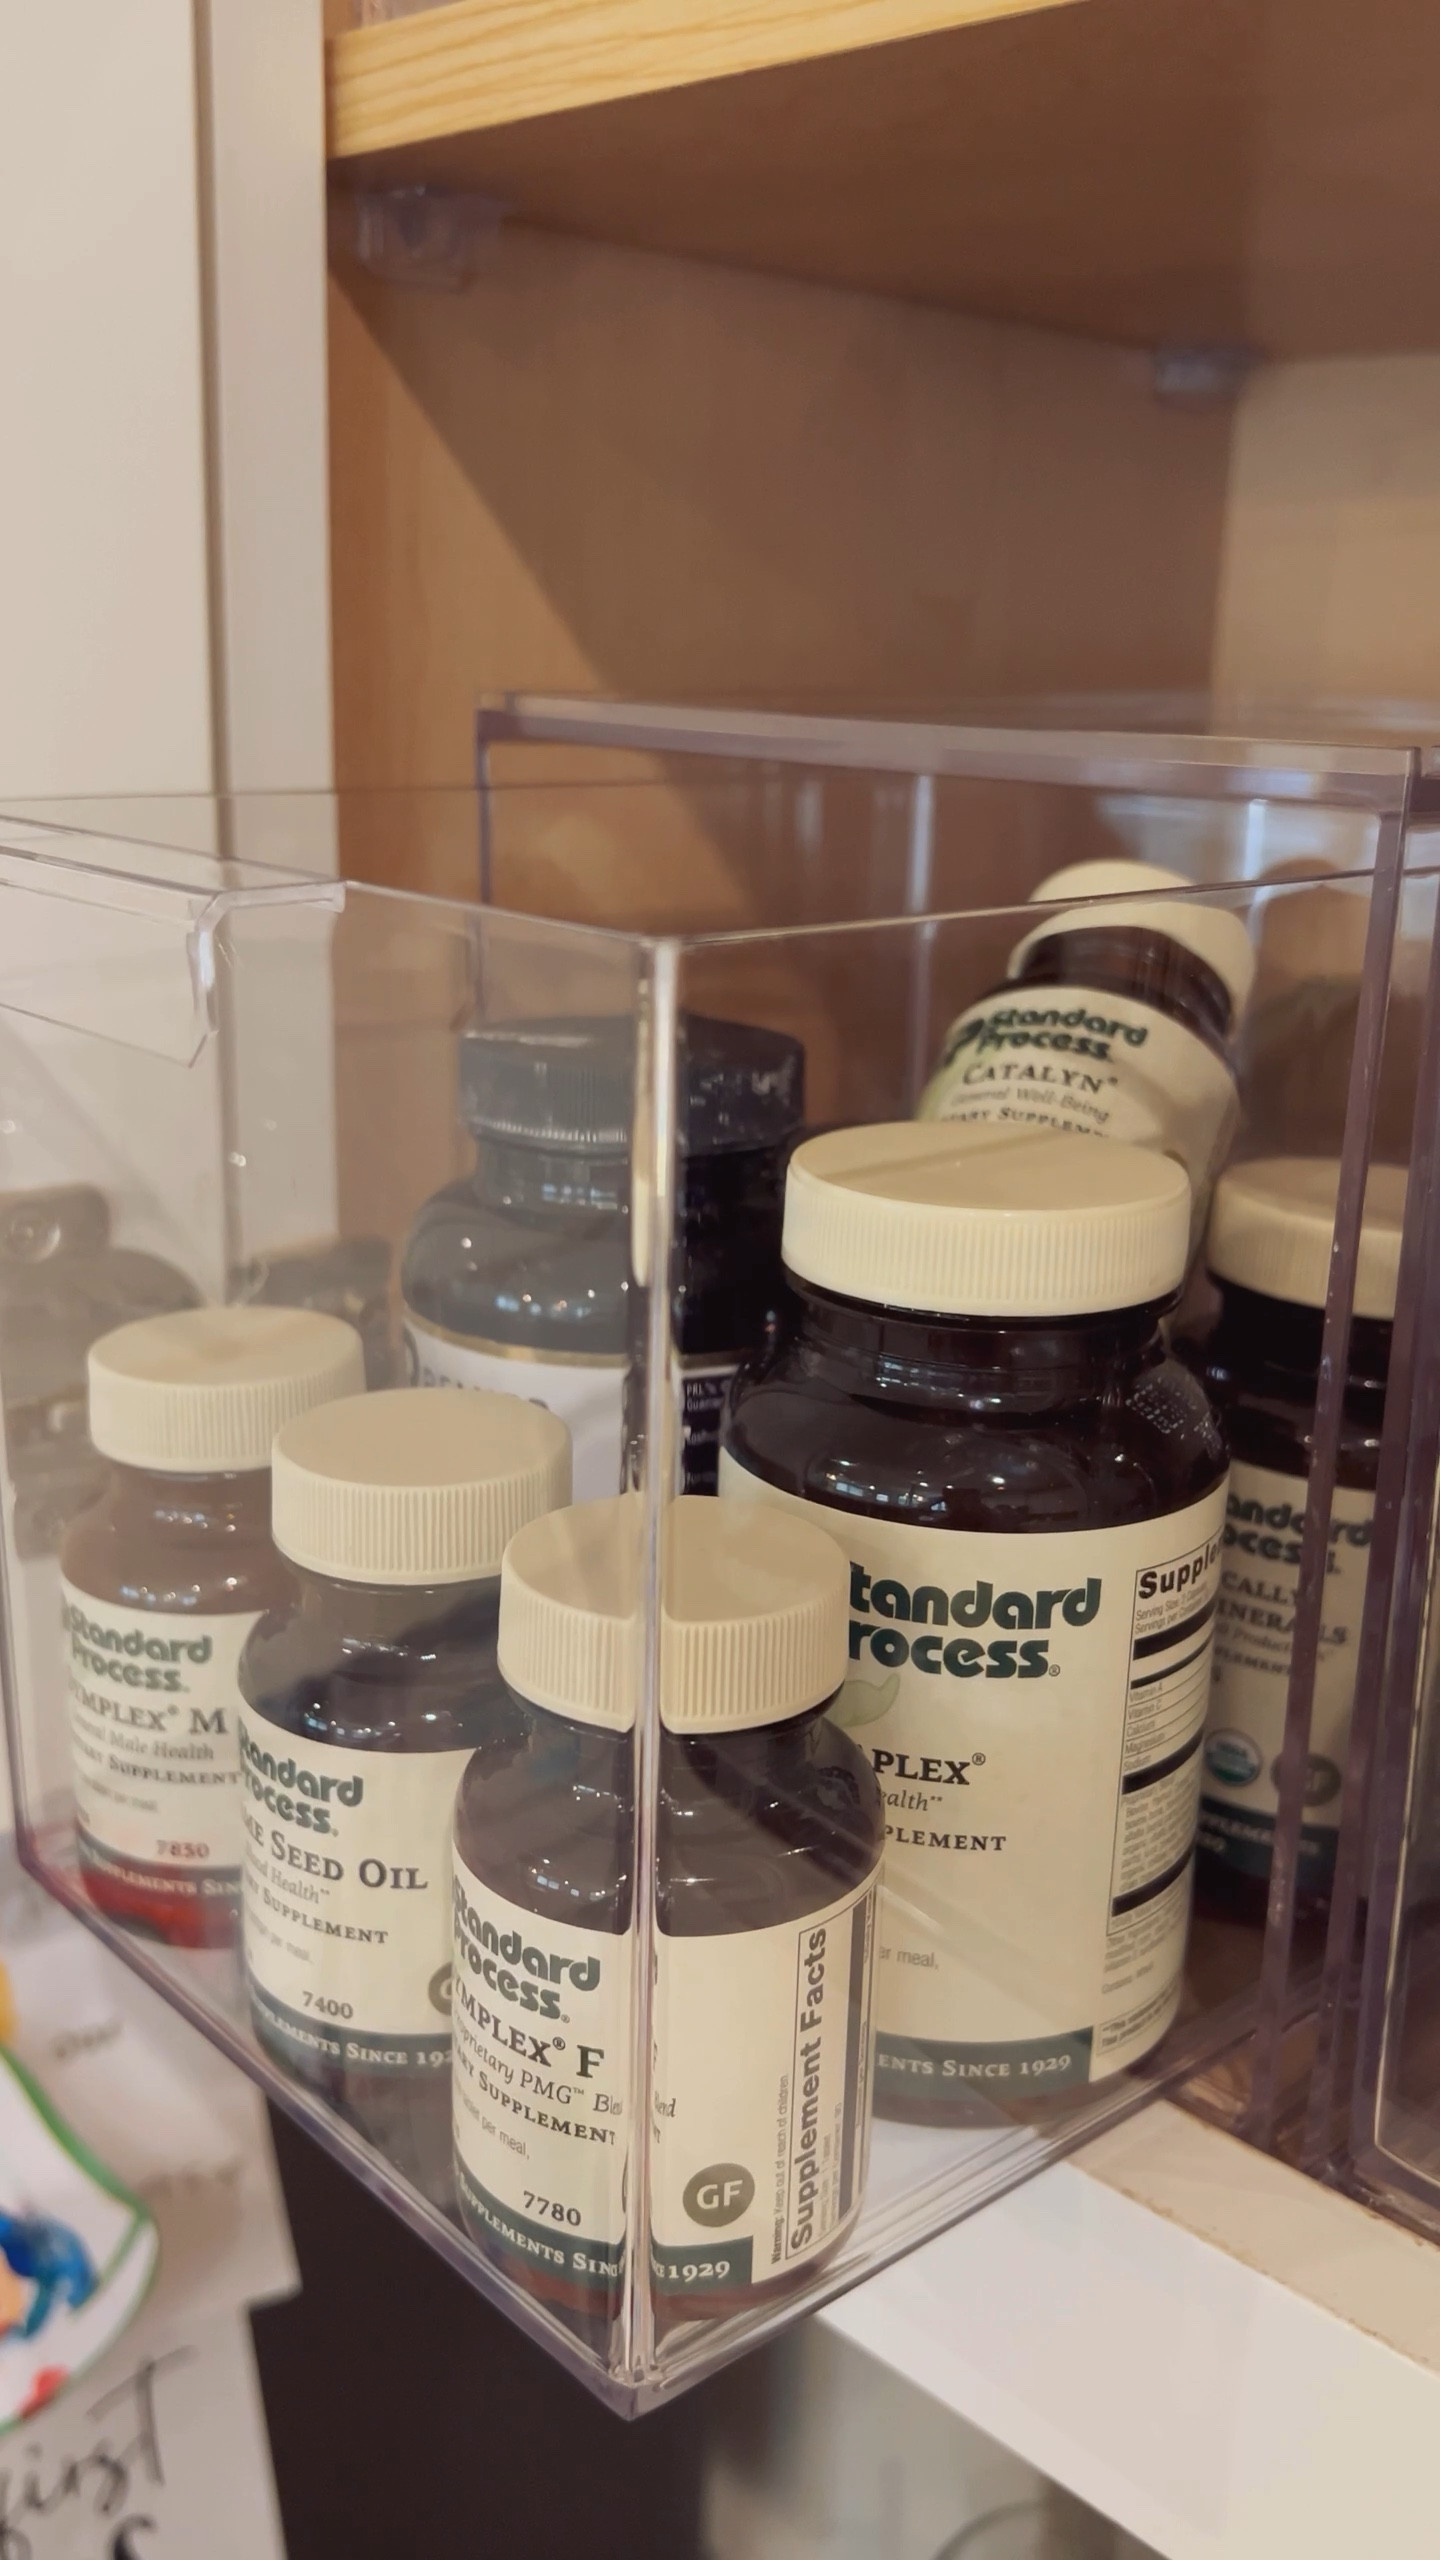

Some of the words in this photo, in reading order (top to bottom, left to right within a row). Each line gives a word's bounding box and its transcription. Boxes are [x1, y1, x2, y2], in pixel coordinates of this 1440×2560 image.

[1138, 1543, 1218, 1600] Supple
[849, 1561, 1102, 1630] tandard
[188, 1707, 229, 1735] M
[884, 1824, 1006, 1851] PLEMENT
[270, 1829, 344, 1881] SEED
[358, 1857, 428, 1890] OIL
[263, 1886, 389, 1944] SUPPLEMENT
[799, 1928, 827, 2033] Facts
[302, 1990, 354, 2020] 7400
[346, 2042, 408, 2065] SINCE
[575, 2044, 605, 2078] F
[942, 2059, 1010, 2077] SINCE
[1019, 2054, 1072, 2077] 1929
[791, 2036, 822, 2250] Supplement
[523, 2190, 582, 2227] 7780
[696, 2179, 744, 2210] GF
[668, 2260, 731, 2283] 1929
